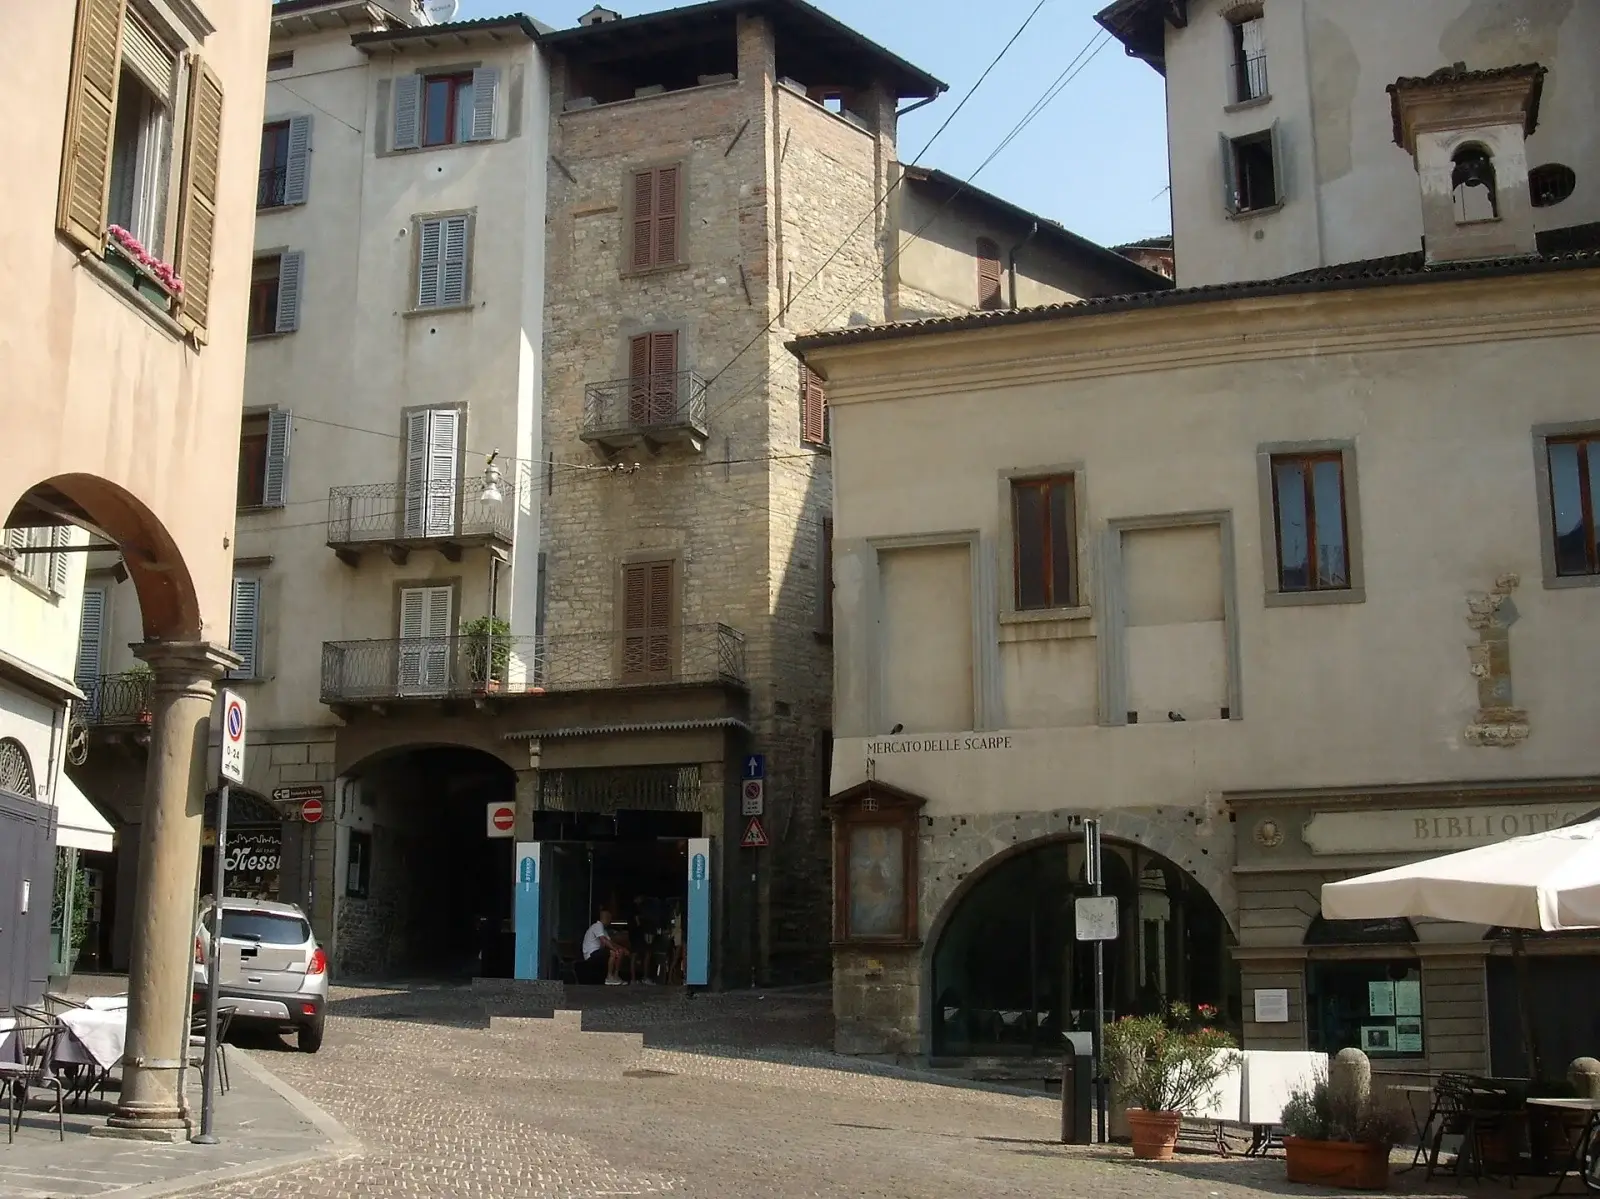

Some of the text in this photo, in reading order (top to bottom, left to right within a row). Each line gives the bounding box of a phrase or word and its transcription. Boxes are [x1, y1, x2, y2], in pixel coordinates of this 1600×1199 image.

[867, 736, 1012, 755] MERCATO DELLE SCARPE
